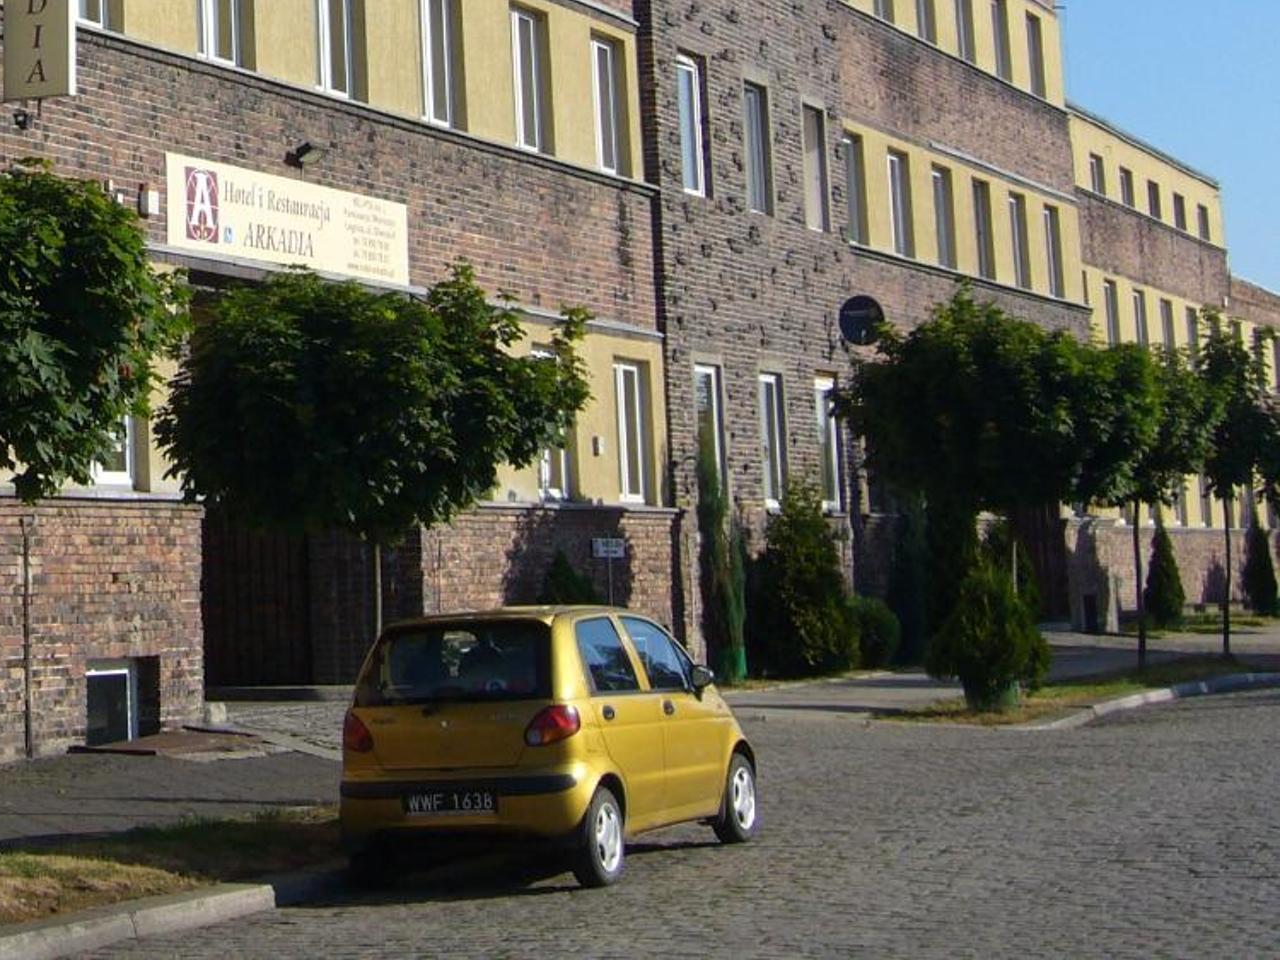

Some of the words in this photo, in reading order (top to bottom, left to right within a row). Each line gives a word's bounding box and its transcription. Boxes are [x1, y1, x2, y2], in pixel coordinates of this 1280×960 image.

[223, 180, 256, 207] Hotel
[258, 186, 264, 209] i
[267, 189, 331, 231] Restauracja
[242, 221, 314, 258] ARKADIA
[408, 793, 444, 812] WWF
